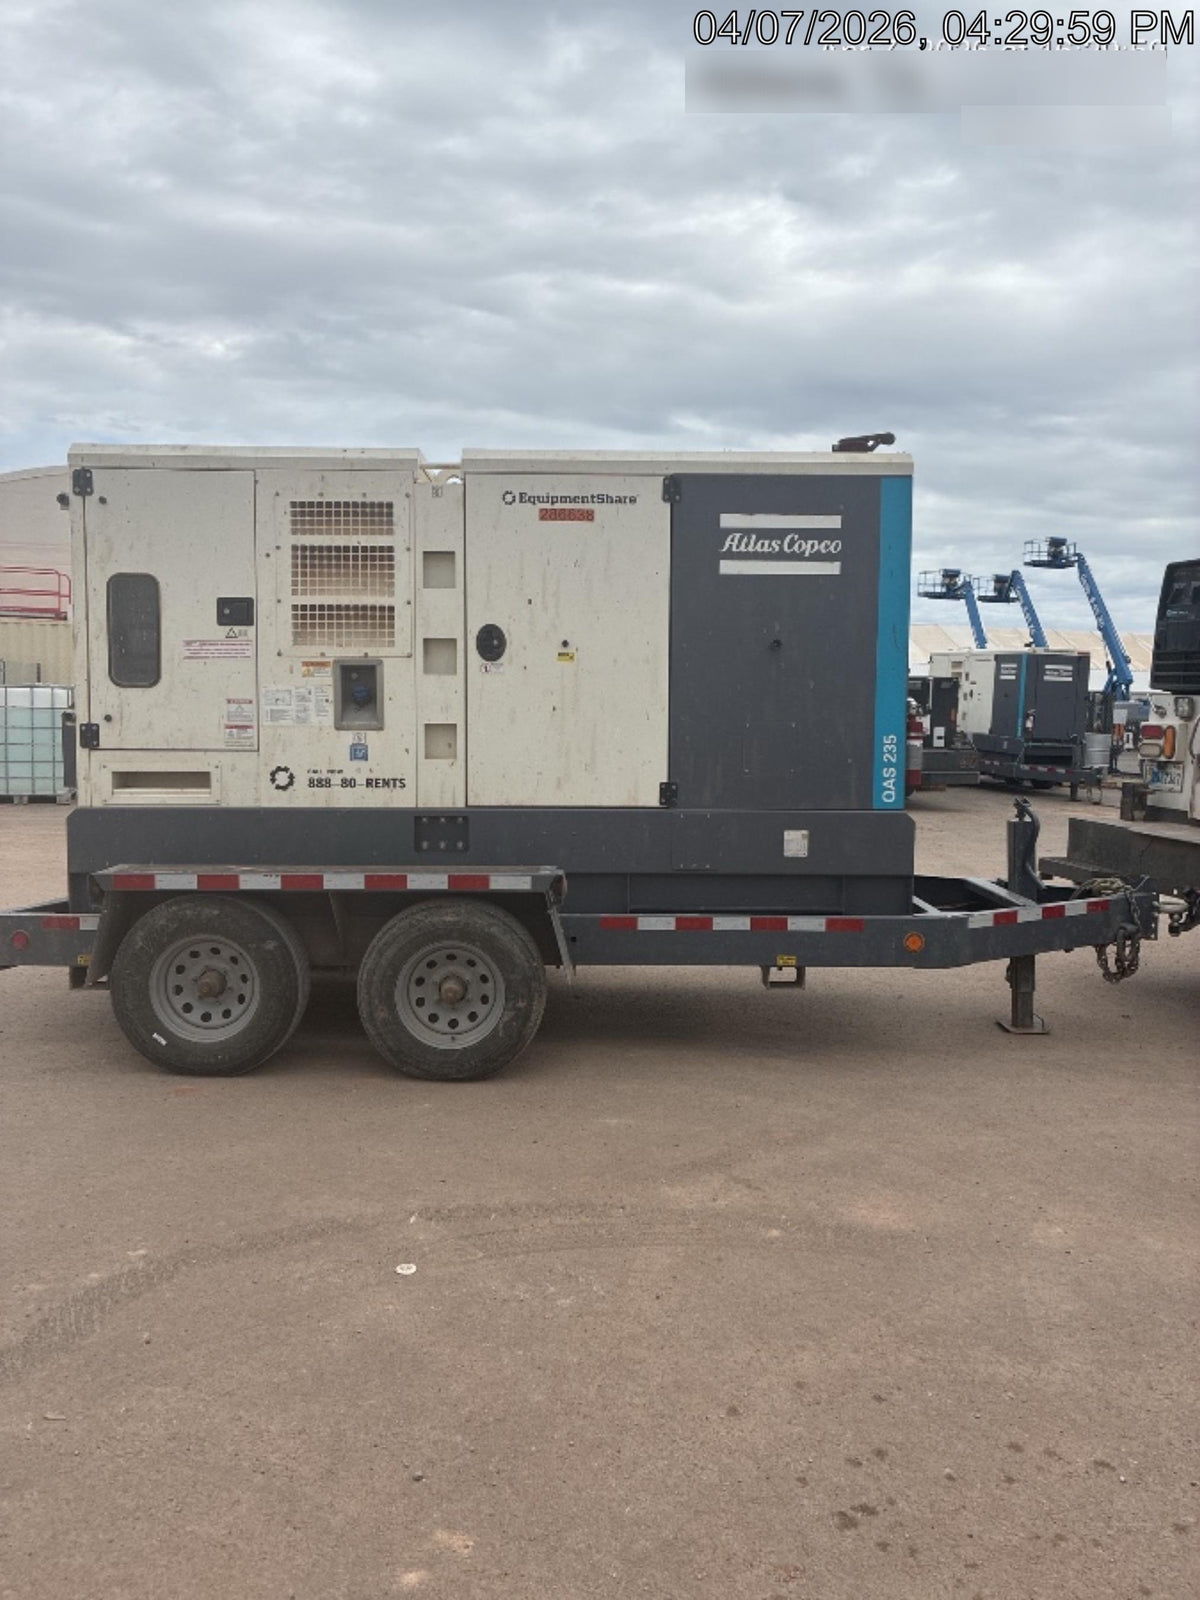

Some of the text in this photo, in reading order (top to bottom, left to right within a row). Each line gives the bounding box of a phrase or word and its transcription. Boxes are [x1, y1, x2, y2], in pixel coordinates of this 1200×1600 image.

[519, 492, 637, 506] EquipmentShare
[720, 532, 842, 557] Atlas Copco
[882, 734, 897, 804] QAS 235
